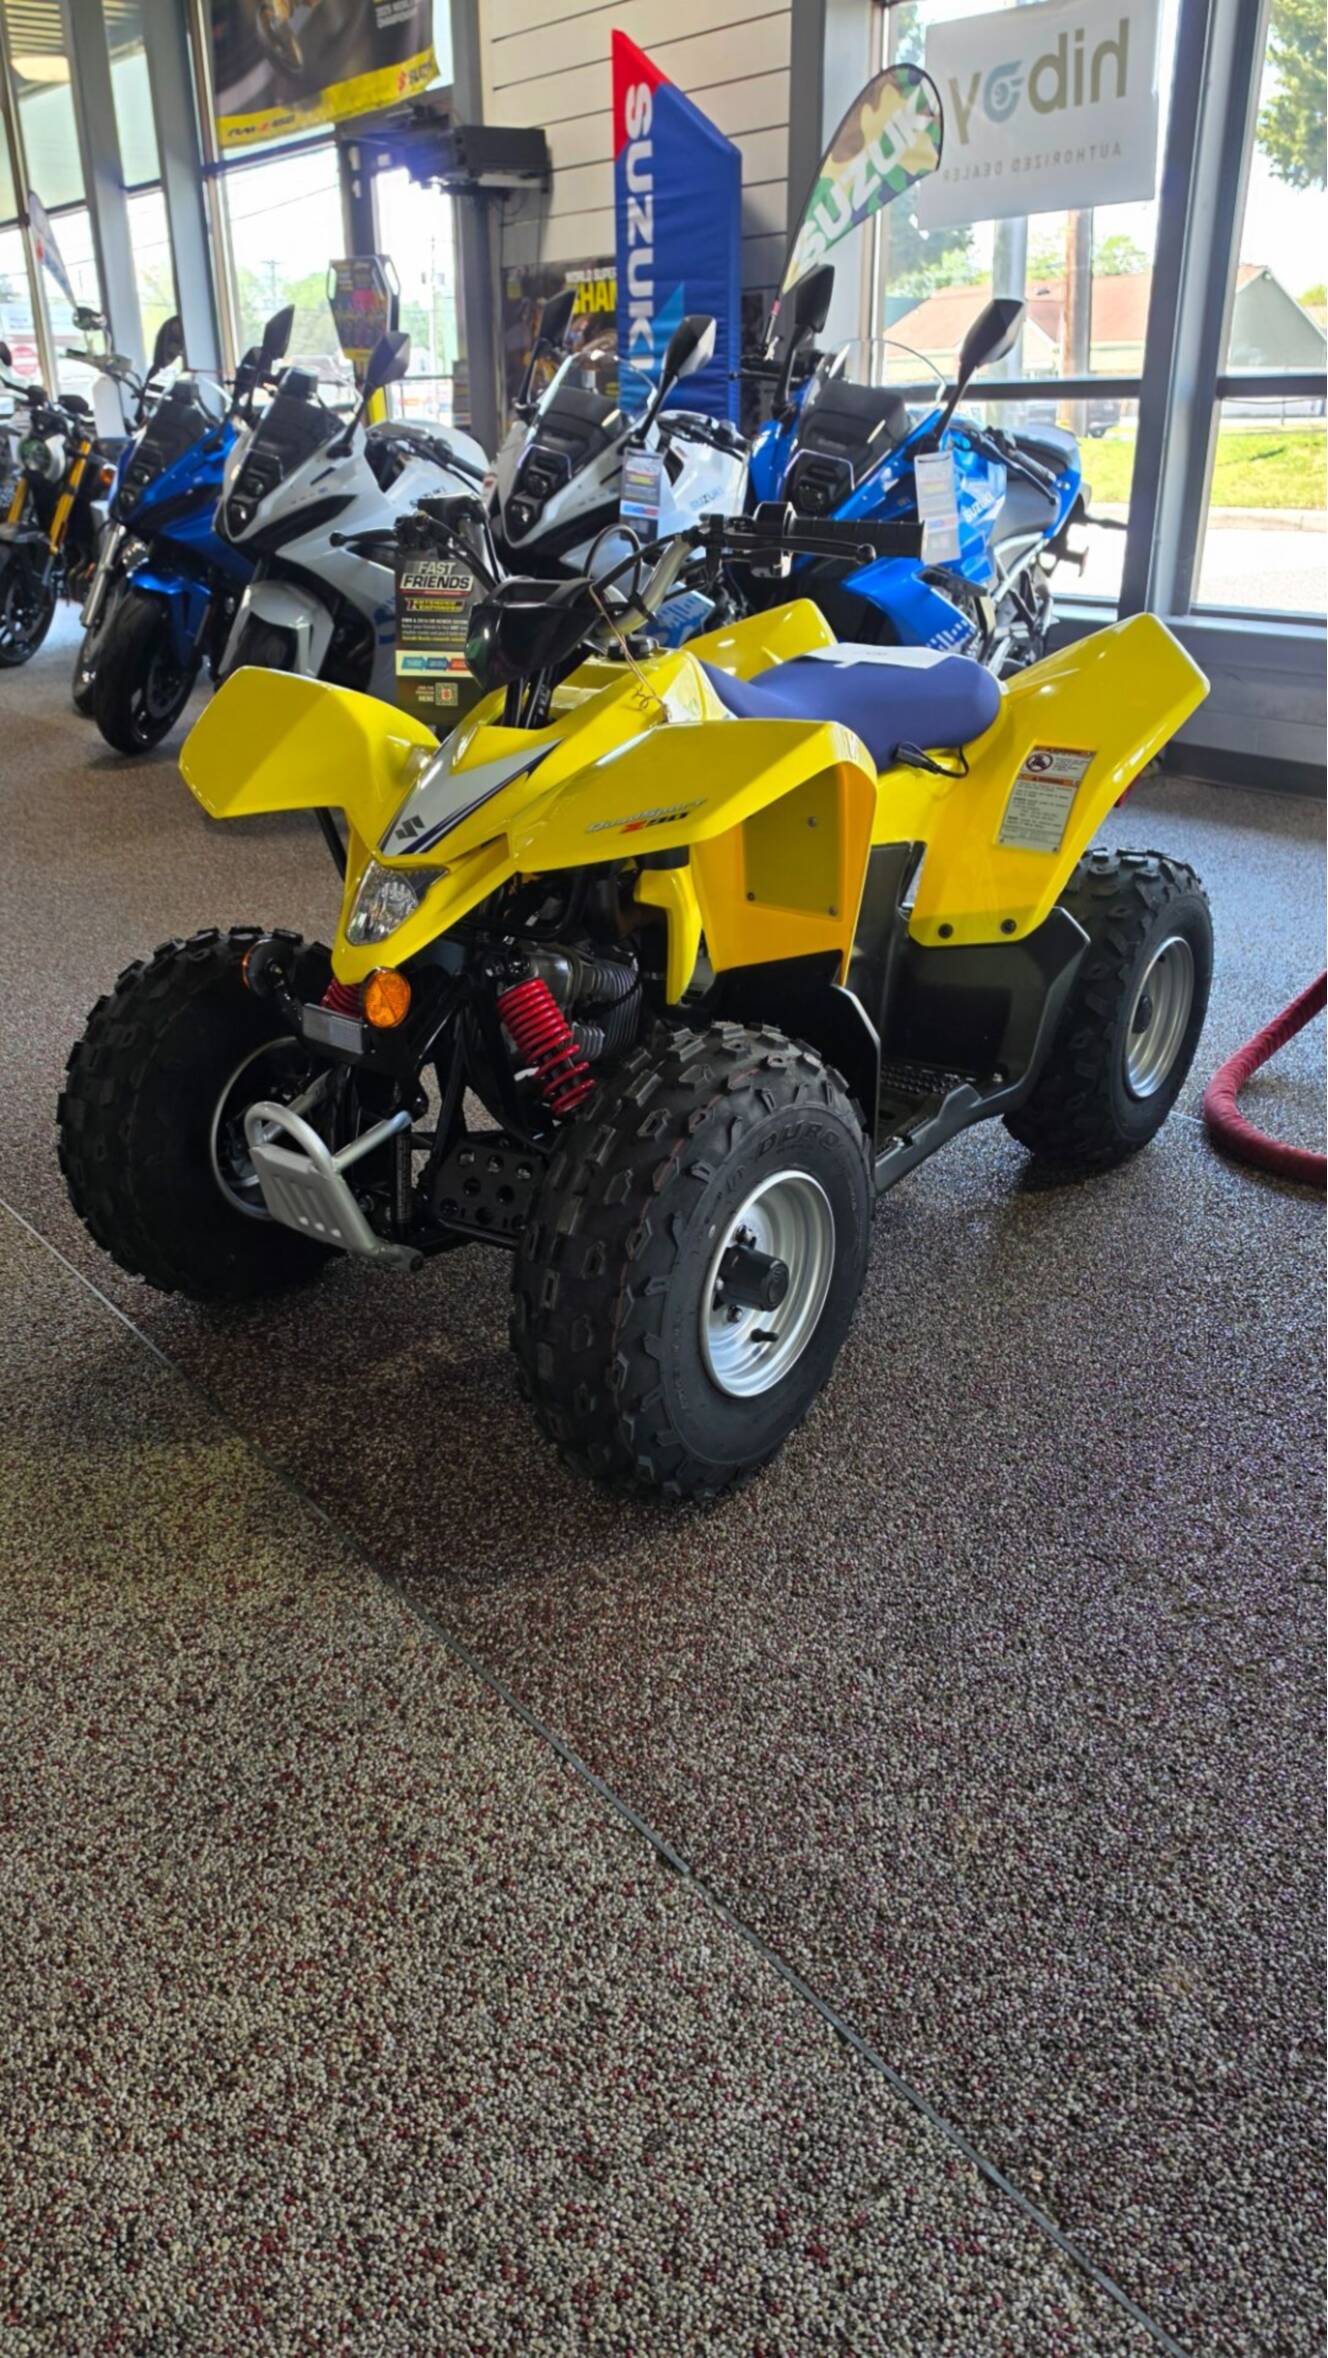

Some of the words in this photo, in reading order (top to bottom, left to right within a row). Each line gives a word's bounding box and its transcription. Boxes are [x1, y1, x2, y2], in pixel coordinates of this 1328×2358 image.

[625, 82, 654, 370] SUZUKI
[594, 266, 616, 281] SUPE
[418, 561, 456, 575] FAST
[403, 574, 470, 589] FRIENDS
